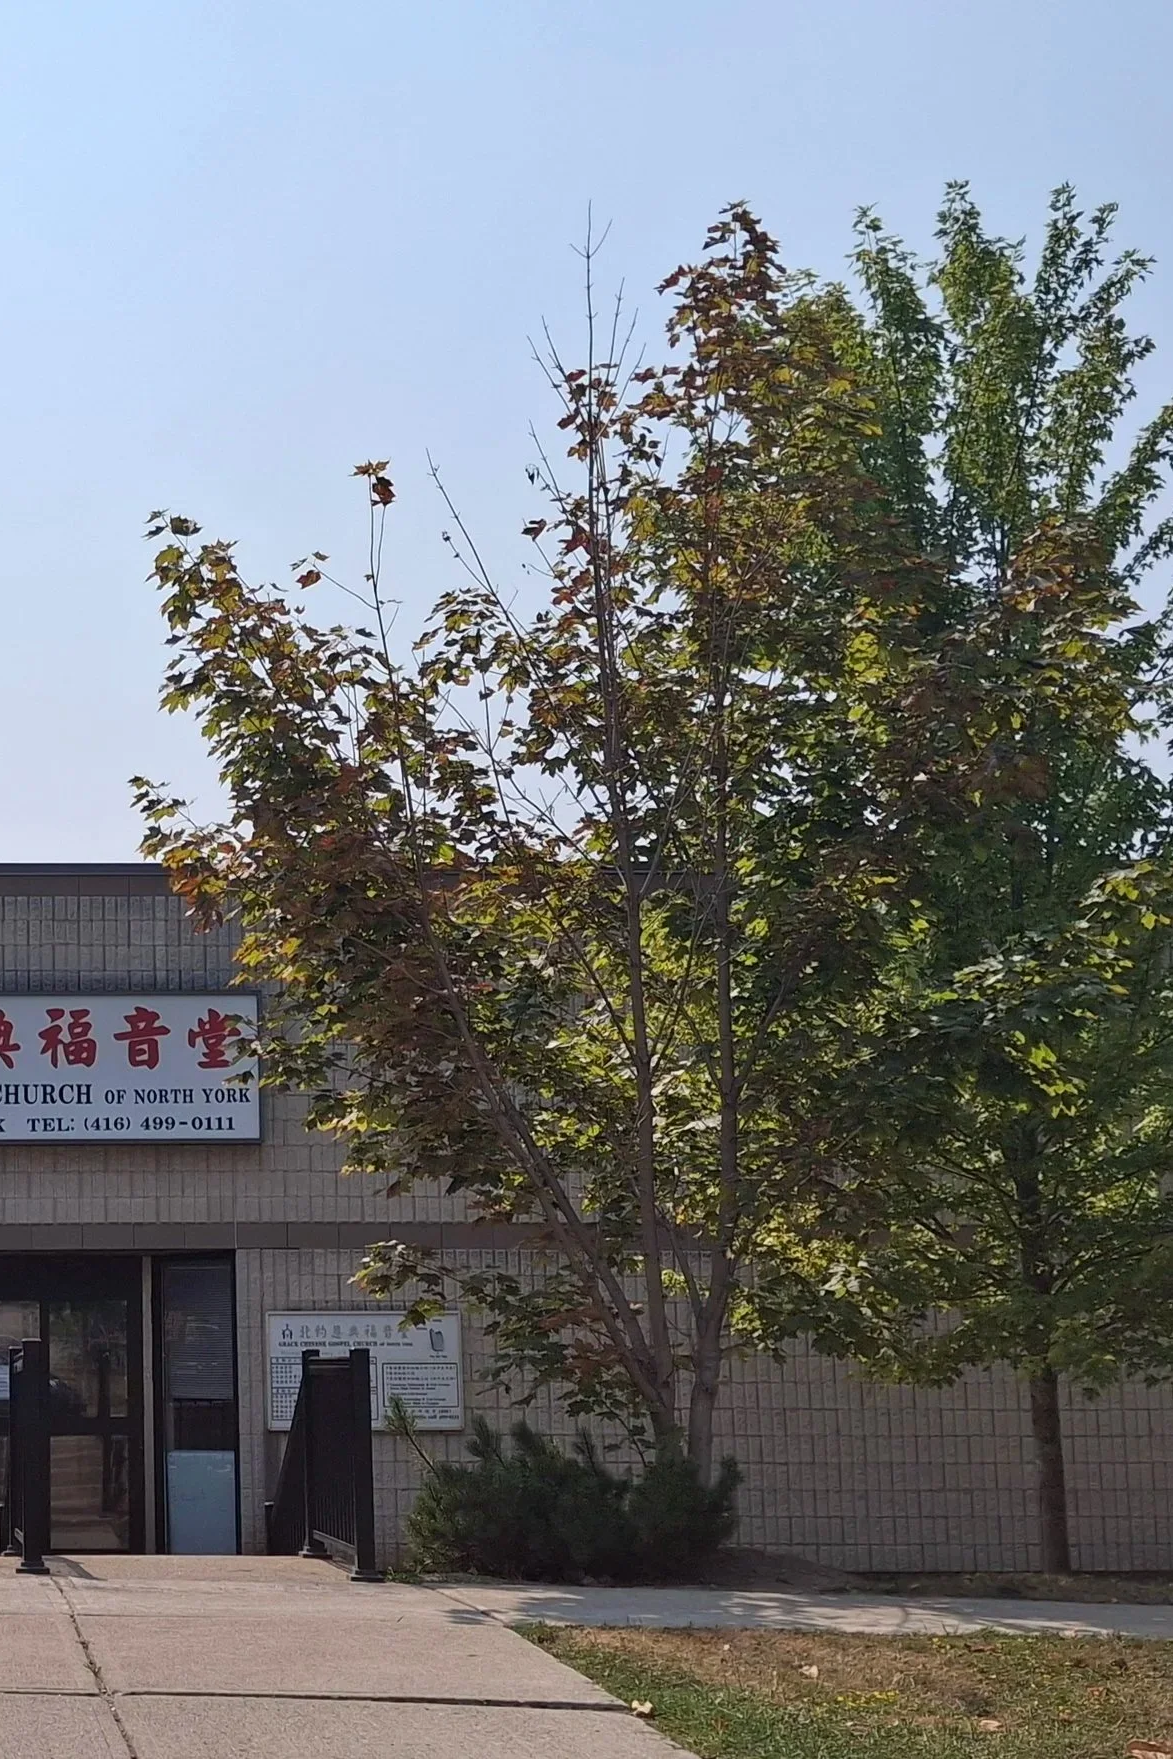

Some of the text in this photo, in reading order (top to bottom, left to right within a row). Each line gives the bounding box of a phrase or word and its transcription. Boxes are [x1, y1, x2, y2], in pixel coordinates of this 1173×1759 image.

[104, 1089, 127, 1105] OF
[133, 1088, 194, 1105] NORTH
[201, 1087, 251, 1104] YORK
[26, 1117, 75, 1133] TEL:
[83, 1116, 131, 1132] (416)
[140, 1115, 236, 1132] 499-0111
